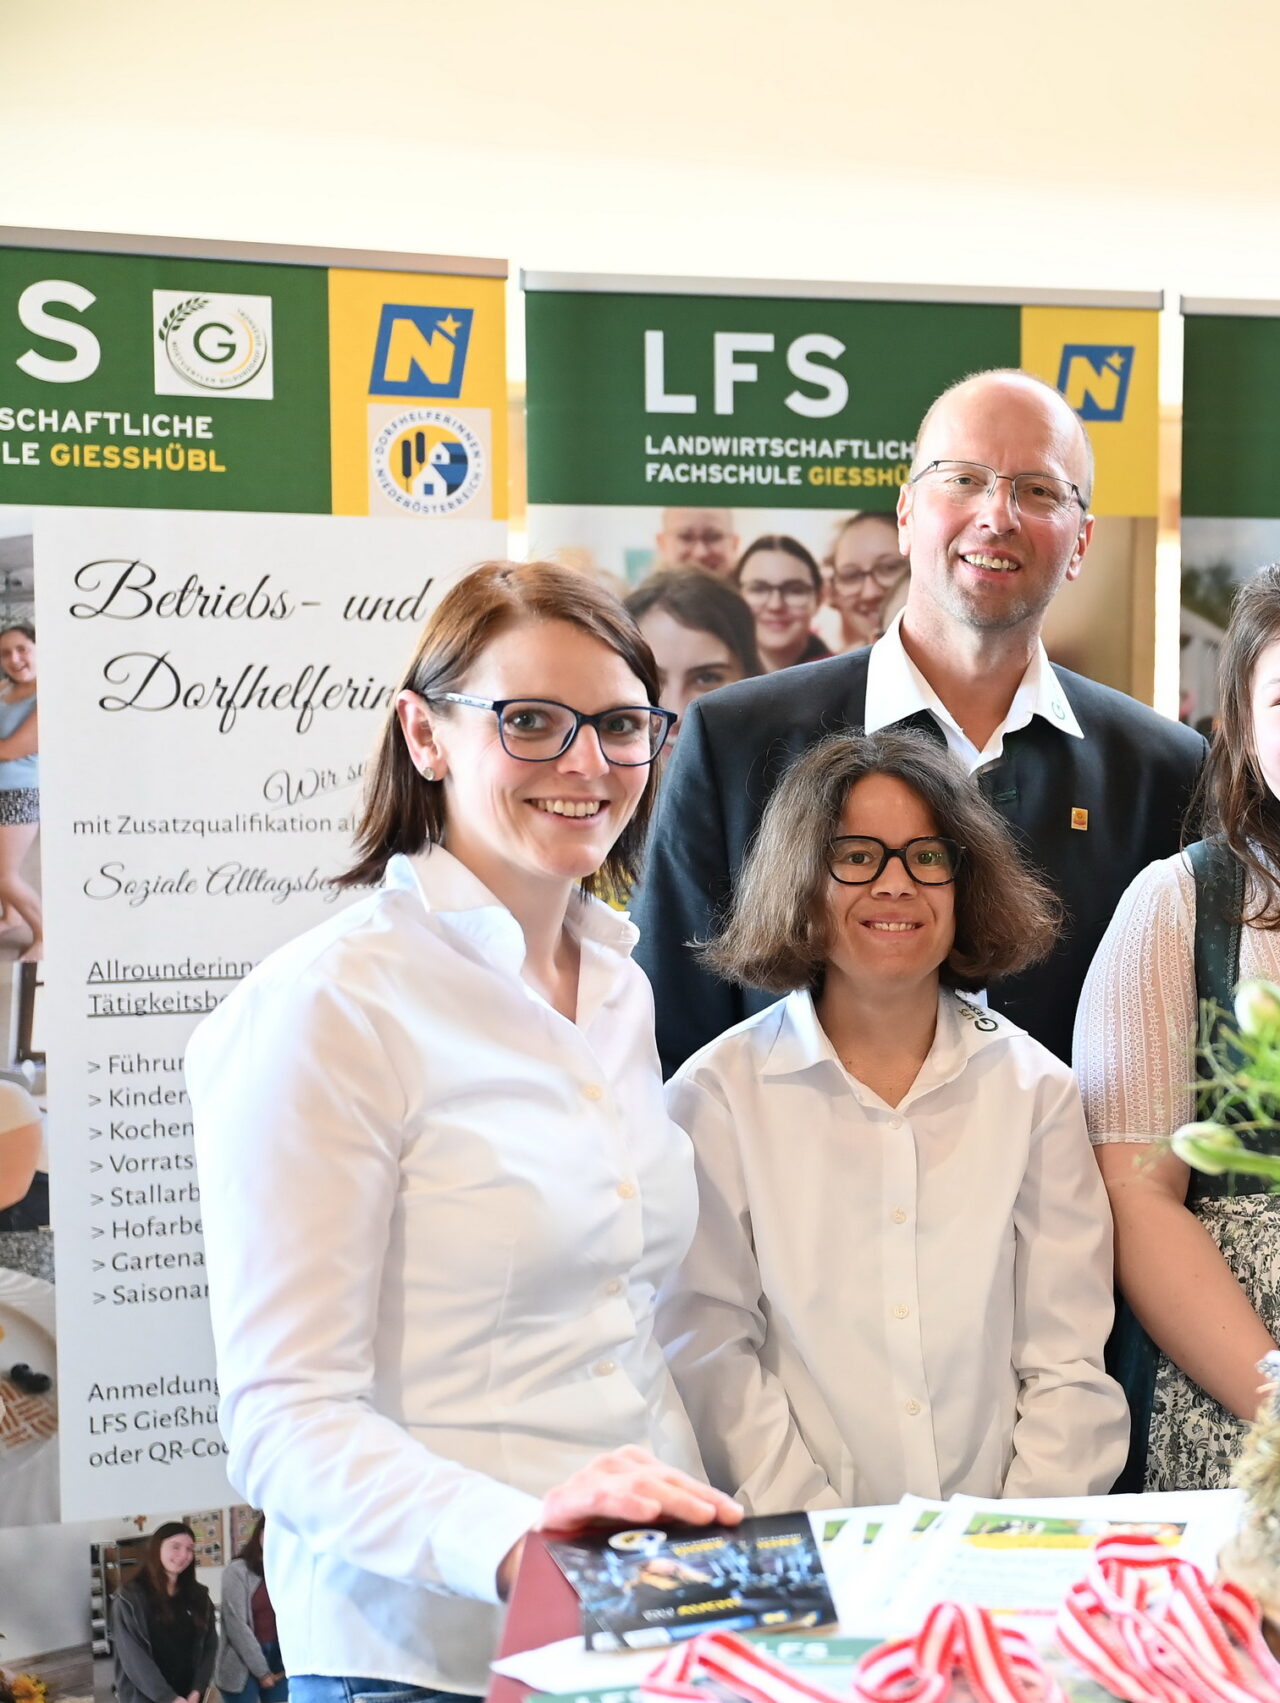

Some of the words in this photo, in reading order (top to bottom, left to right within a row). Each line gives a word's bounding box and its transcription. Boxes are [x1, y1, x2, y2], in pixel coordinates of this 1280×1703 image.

[16, 279, 101, 384] S
[644, 329, 849, 418] LFS
[0, 407, 214, 440] SCHAFTLICHE
[50, 442, 227, 473] GIESSHÜBL
[645, 462, 802, 486] FACHSCHULE
[343, 577, 435, 624] und
[263, 767, 338, 807] Wir
[73, 815, 113, 836] mit
[117, 813, 332, 841] Zusatzqualifikation
[84, 861, 198, 909] Soziale
[89, 1413, 128, 1436] LFS
[134, 1404, 218, 1431] Gießhü
[89, 1446, 144, 1469] oder
